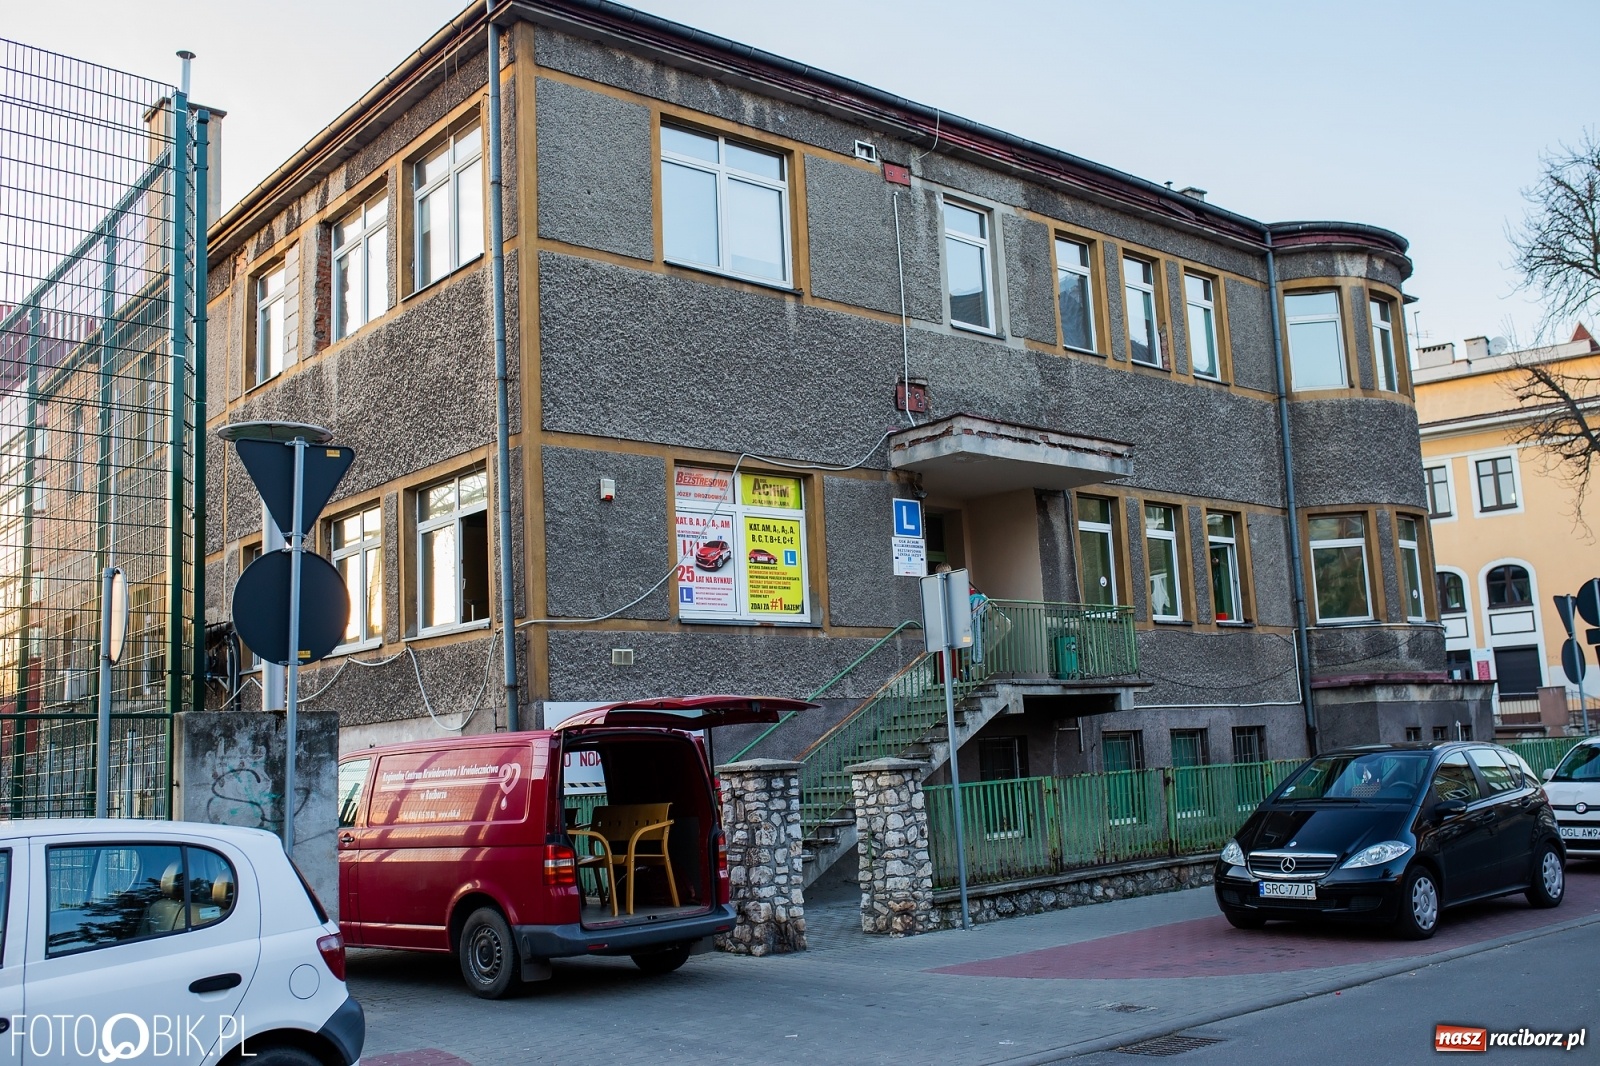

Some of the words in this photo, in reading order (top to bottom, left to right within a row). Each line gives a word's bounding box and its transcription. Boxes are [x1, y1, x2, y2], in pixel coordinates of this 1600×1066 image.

[902, 505, 916, 530] L
[678, 565, 695, 582] 25
[770, 597, 783, 611] #1
[1265, 883, 1286, 895] SRC
